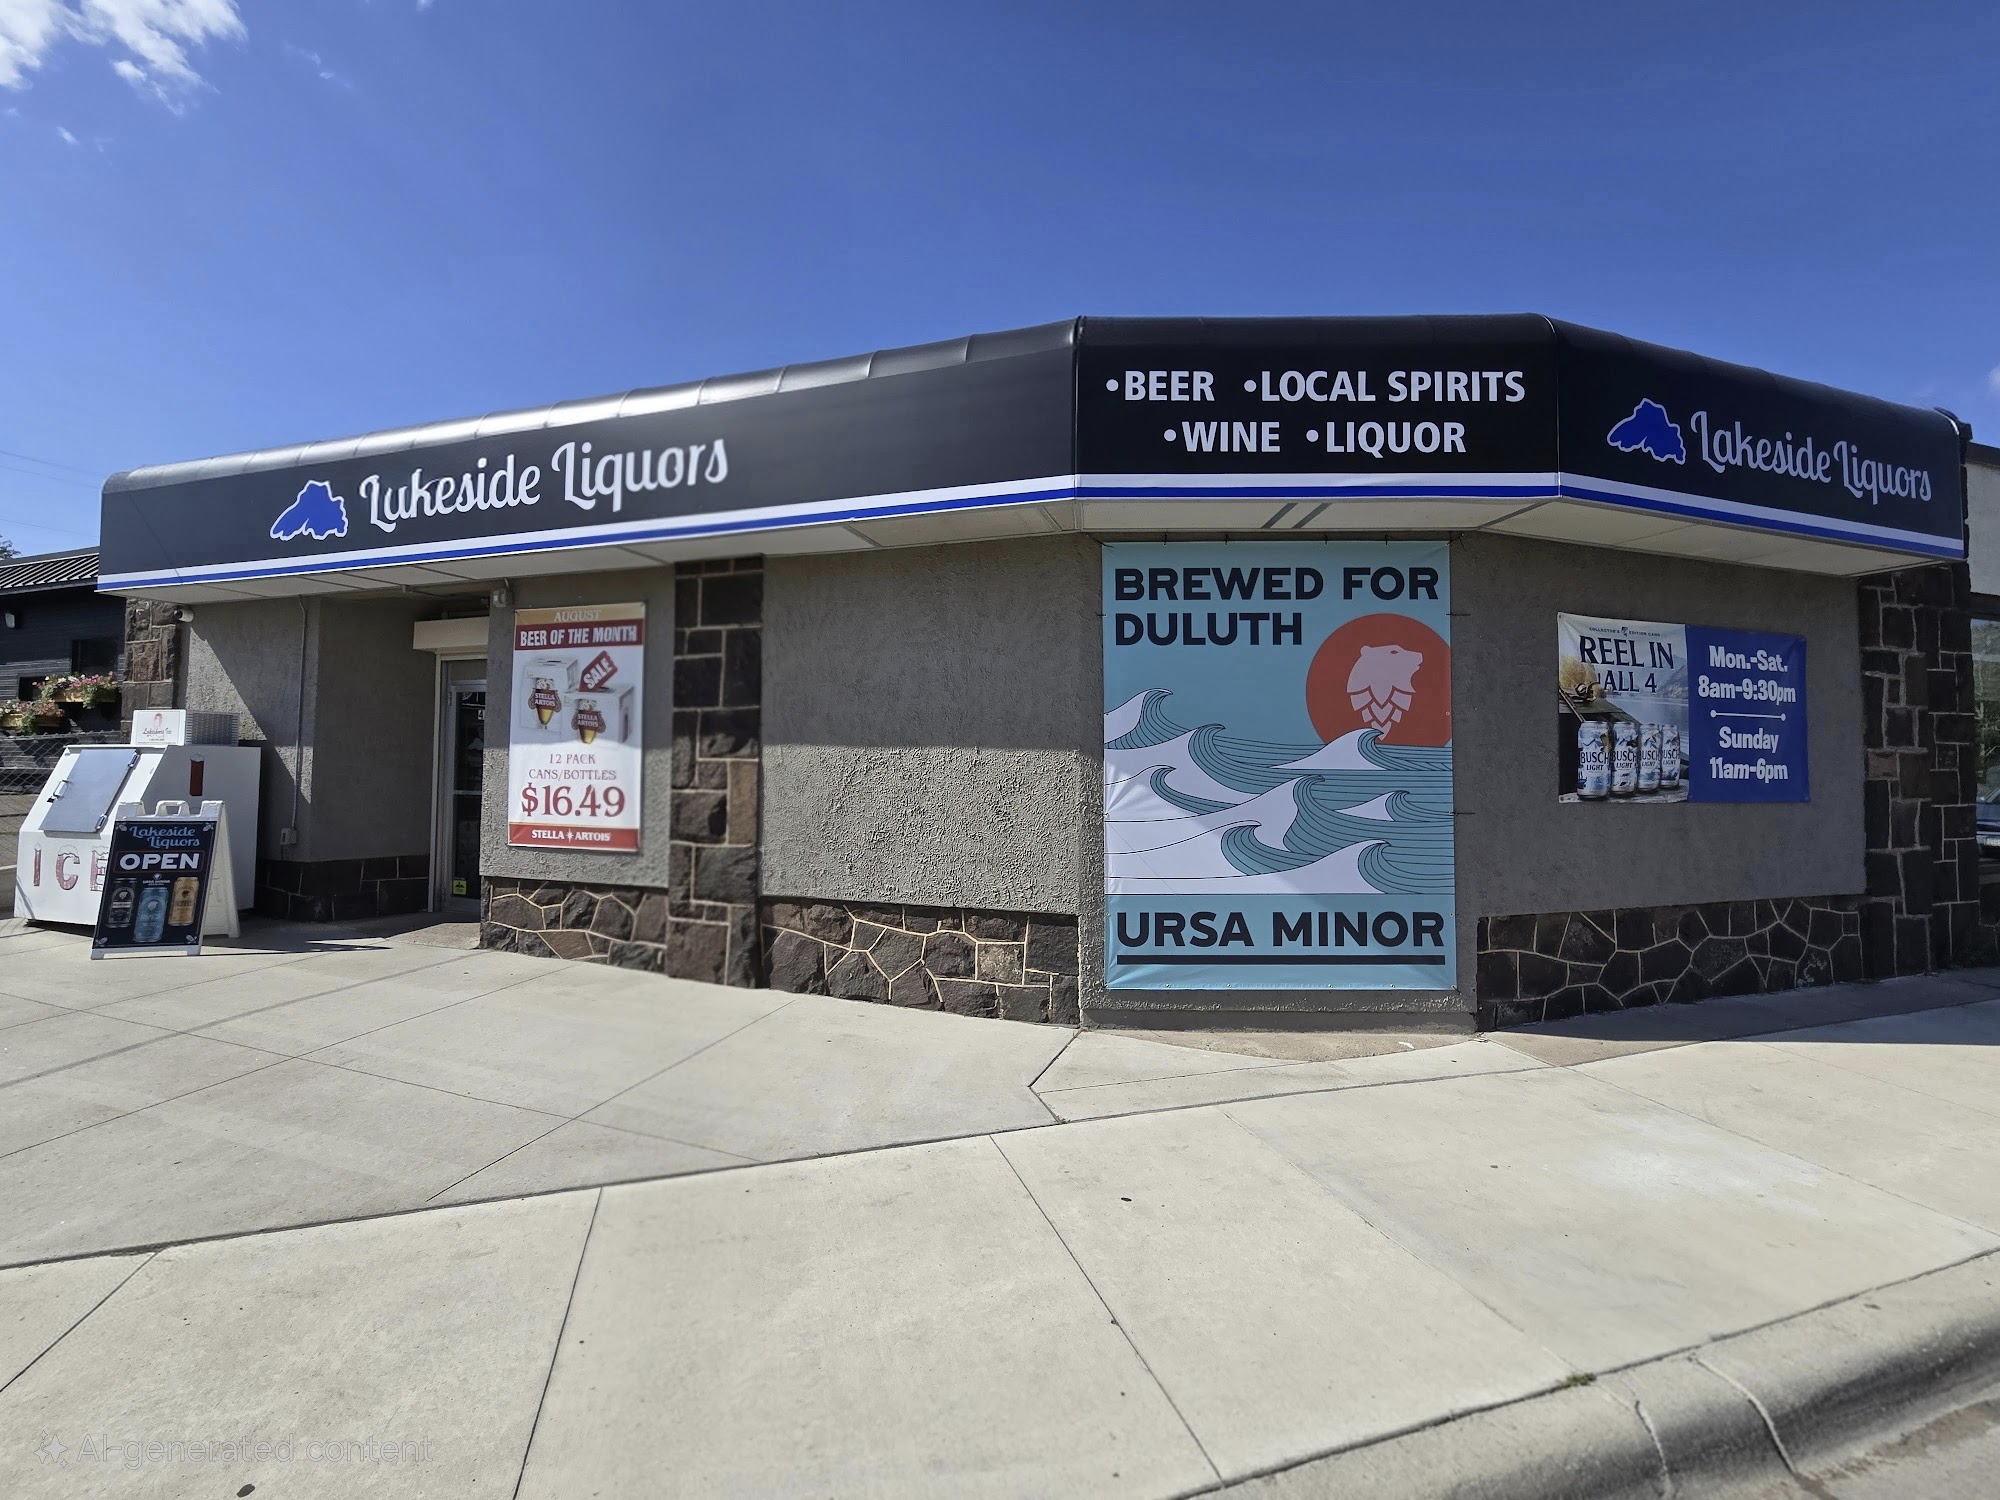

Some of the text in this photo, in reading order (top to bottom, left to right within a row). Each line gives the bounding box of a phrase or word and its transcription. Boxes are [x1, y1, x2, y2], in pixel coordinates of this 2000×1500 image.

[1124, 370, 1526, 402] BEER LOCAL SPIRITS
[1182, 421, 1466, 459] WINE LIQUOR
[1690, 410, 1932, 506] Lakeside Liquors
[551, 438, 729, 512] Liquors
[1114, 566, 1439, 601] BREWED FOR
[554, 609, 602, 623] AUGUST
[1114, 612, 1303, 646] DULUTH
[520, 625, 637, 647] BEER OF THE MONTH
[1579, 634, 1674, 669] REEL IN
[1709, 645, 1788, 672] Mon.-Sat.
[583, 657, 613, 689] SALE
[1604, 669, 1658, 694] ALL 4
[534, 692, 556, 700] STELLA
[1698, 675, 1796, 705] 8am-9:30pm
[577, 713, 598, 721] STELLA
[1719, 726, 1779, 753] Sunday
[549, 753, 596, 764] 12 PACK
[1580, 751, 1609, 764] BUSCH
[1661, 749, 1680, 760] USCH
[528, 768, 617, 781] CANS/BOTTLES
[1709, 756, 1789, 783] 11am-6pm
[521, 782, 625, 817] $16.49
[129, 826, 196, 838] Lakeside
[147, 835, 200, 849] Liquors
[531, 829, 611, 841] STELLA ARTOIS
[33, 845, 109, 891] ICE
[119, 853, 200, 870] OPEN
[1117, 911, 1445, 948] URSA MINOR
